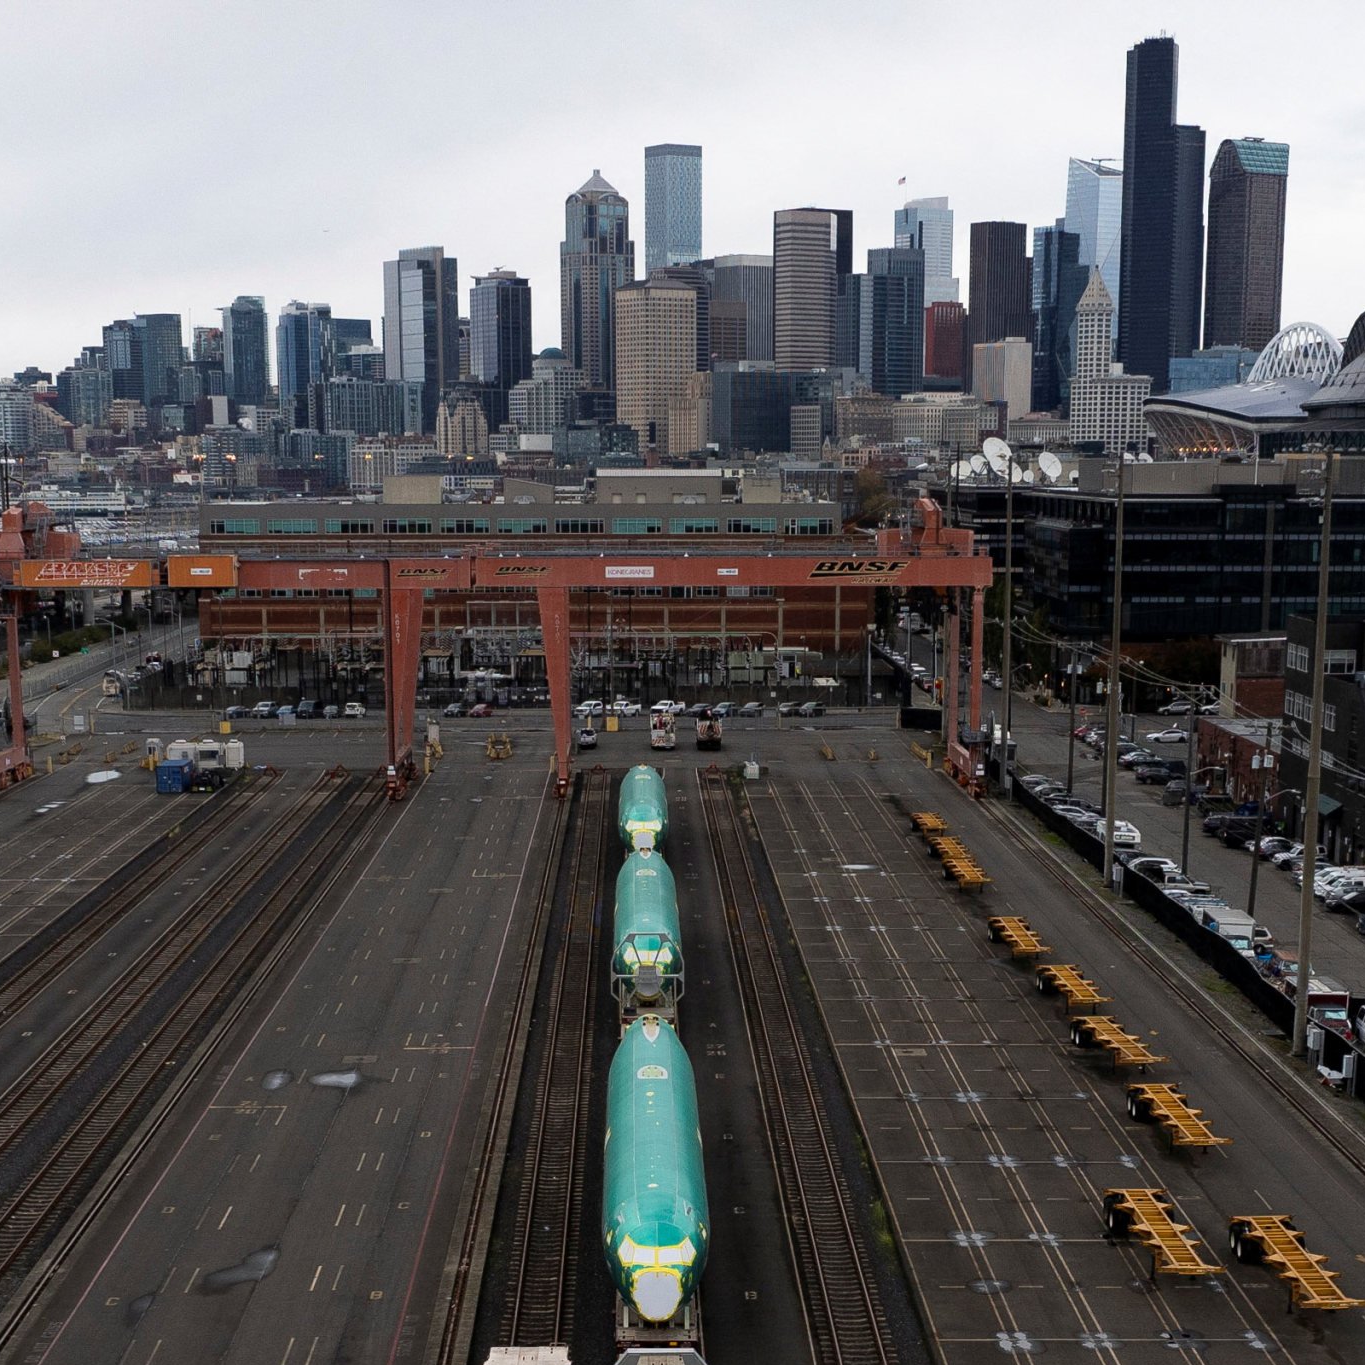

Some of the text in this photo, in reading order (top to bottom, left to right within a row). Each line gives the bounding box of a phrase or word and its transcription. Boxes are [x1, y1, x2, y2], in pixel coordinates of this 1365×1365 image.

[38, 562, 138, 578] BNSF
[813, 561, 910, 573] BNSF
[397, 1201, 411, 1210] C
[733, 1206, 746, 1215] C
[369, 1290, 384, 1300] B
[744, 1290, 758, 1300] B
[104, 1296, 121, 1306] C
